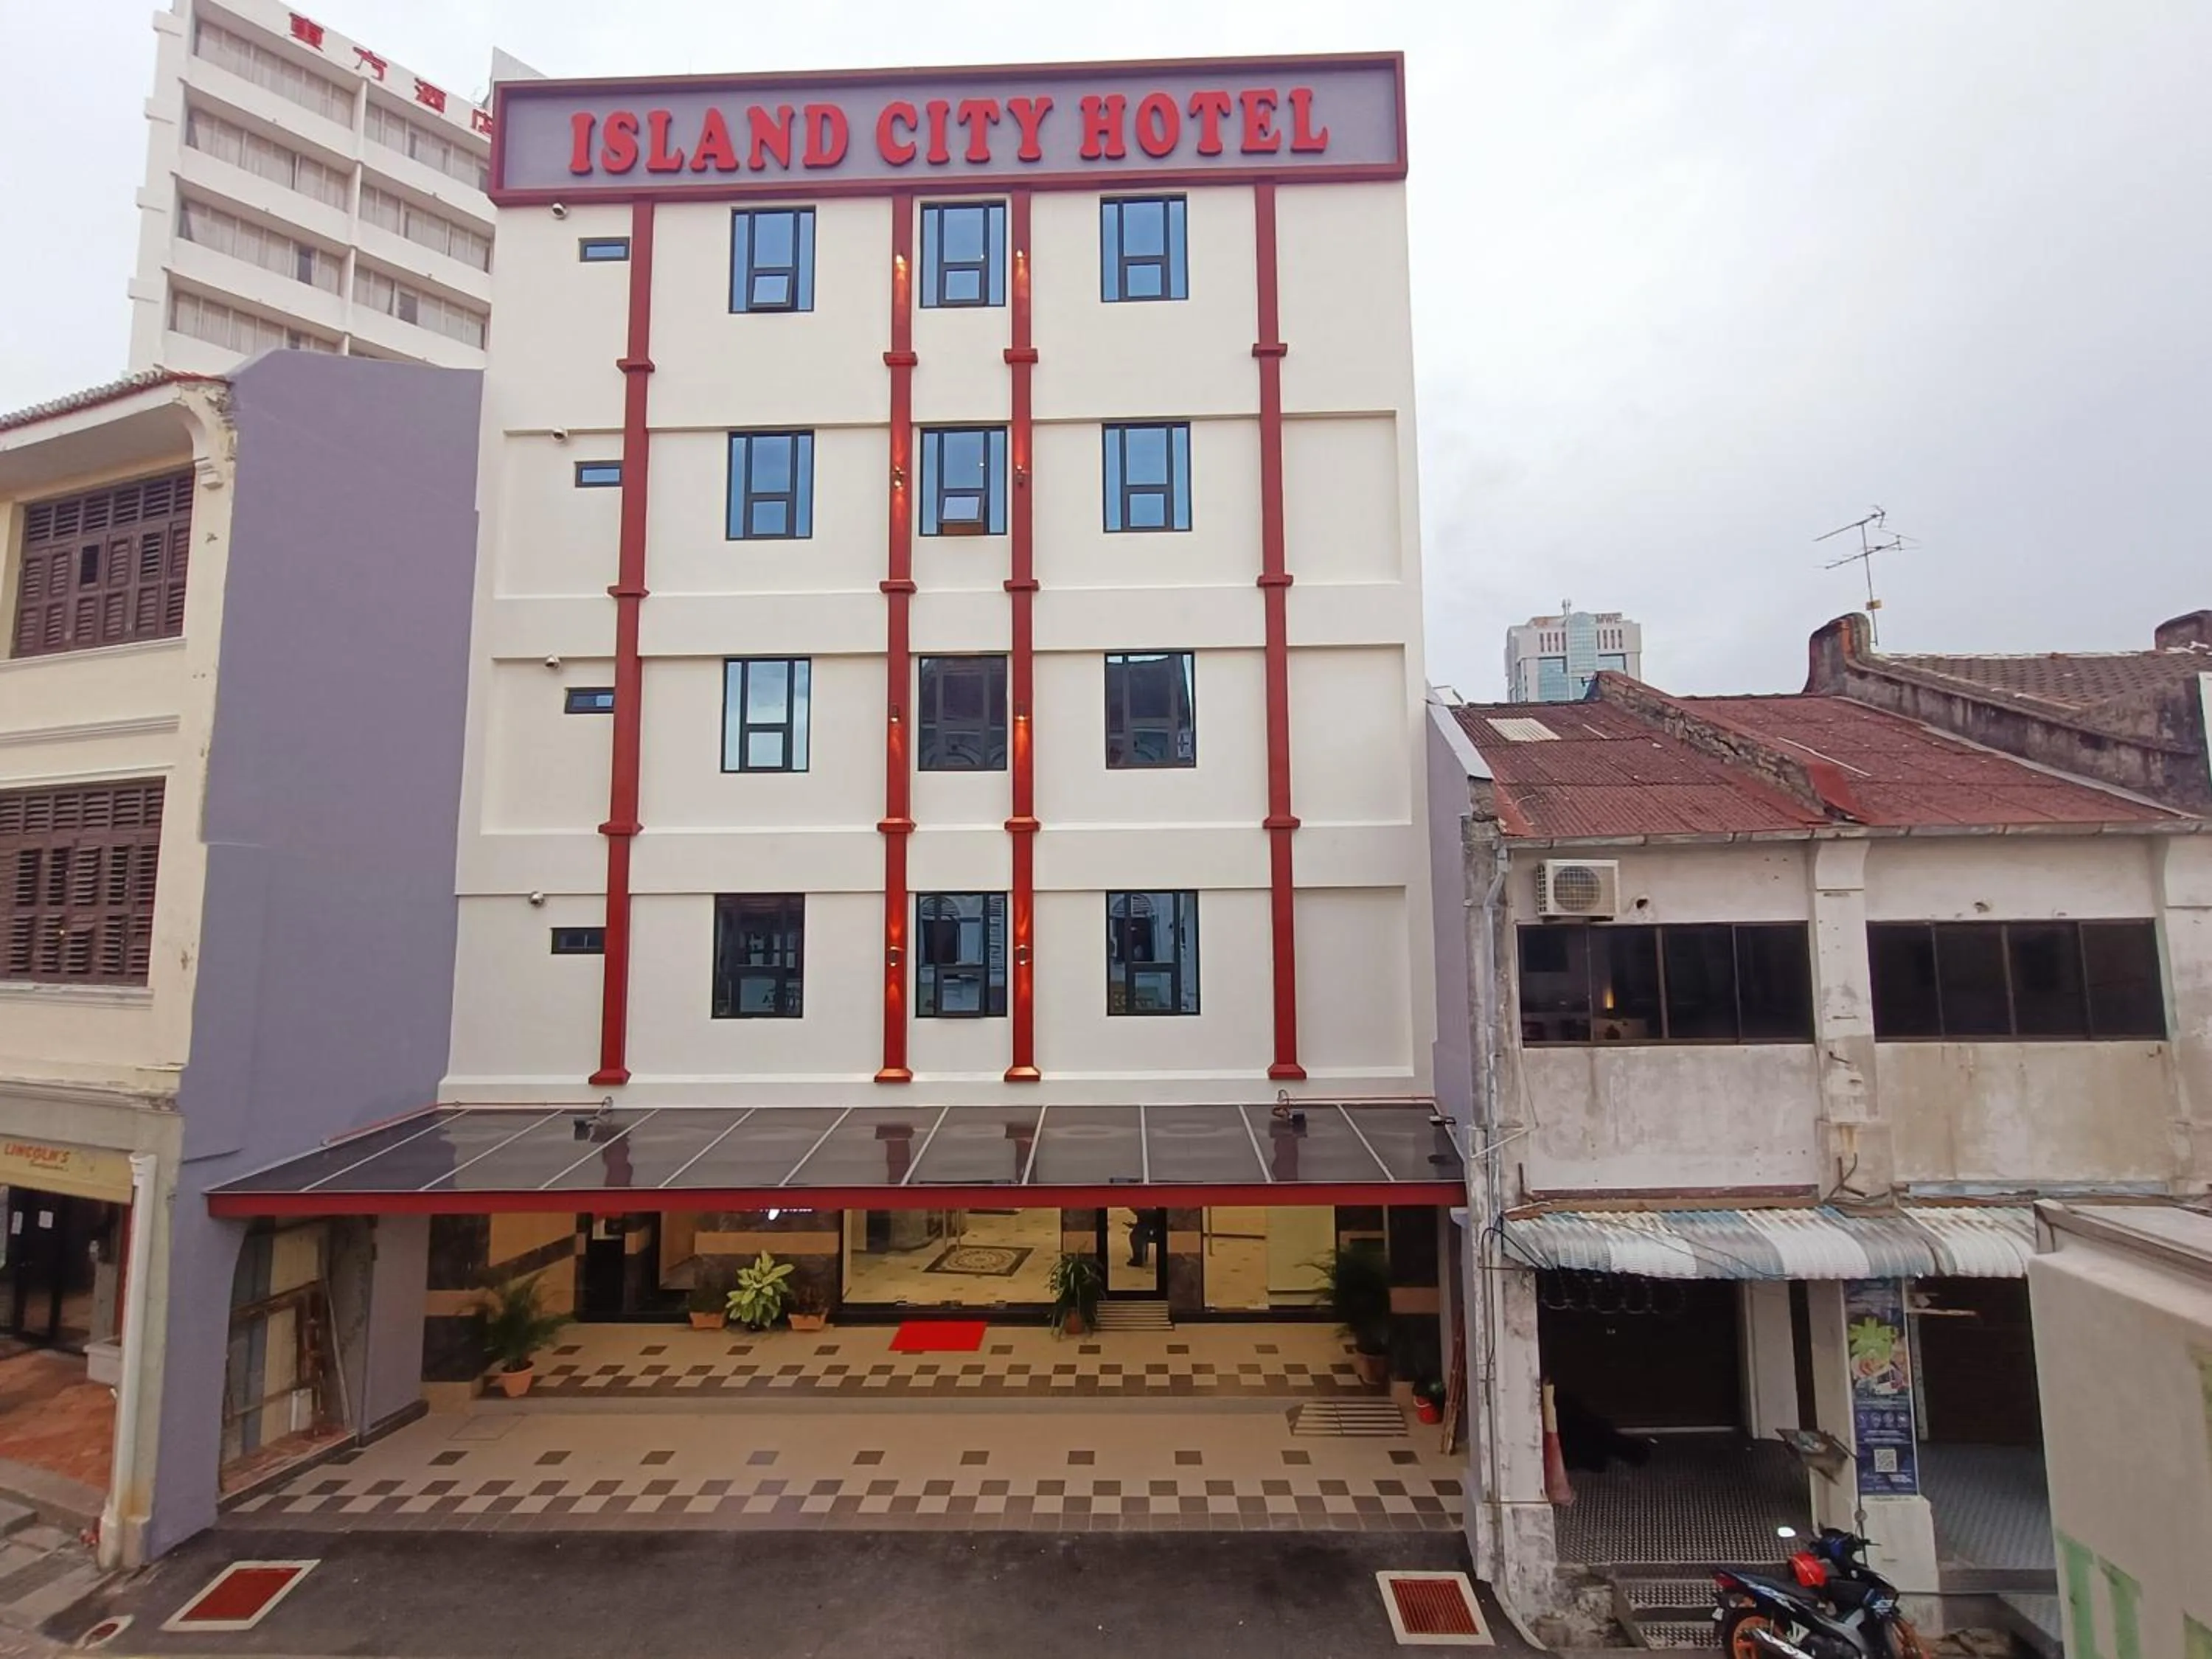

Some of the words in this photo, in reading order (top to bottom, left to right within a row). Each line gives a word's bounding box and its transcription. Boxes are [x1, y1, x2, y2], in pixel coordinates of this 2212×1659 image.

[569, 103, 850, 175] ISLAND
[876, 97, 1053, 167] CITY
[1079, 88, 1329, 160] HOTEL
